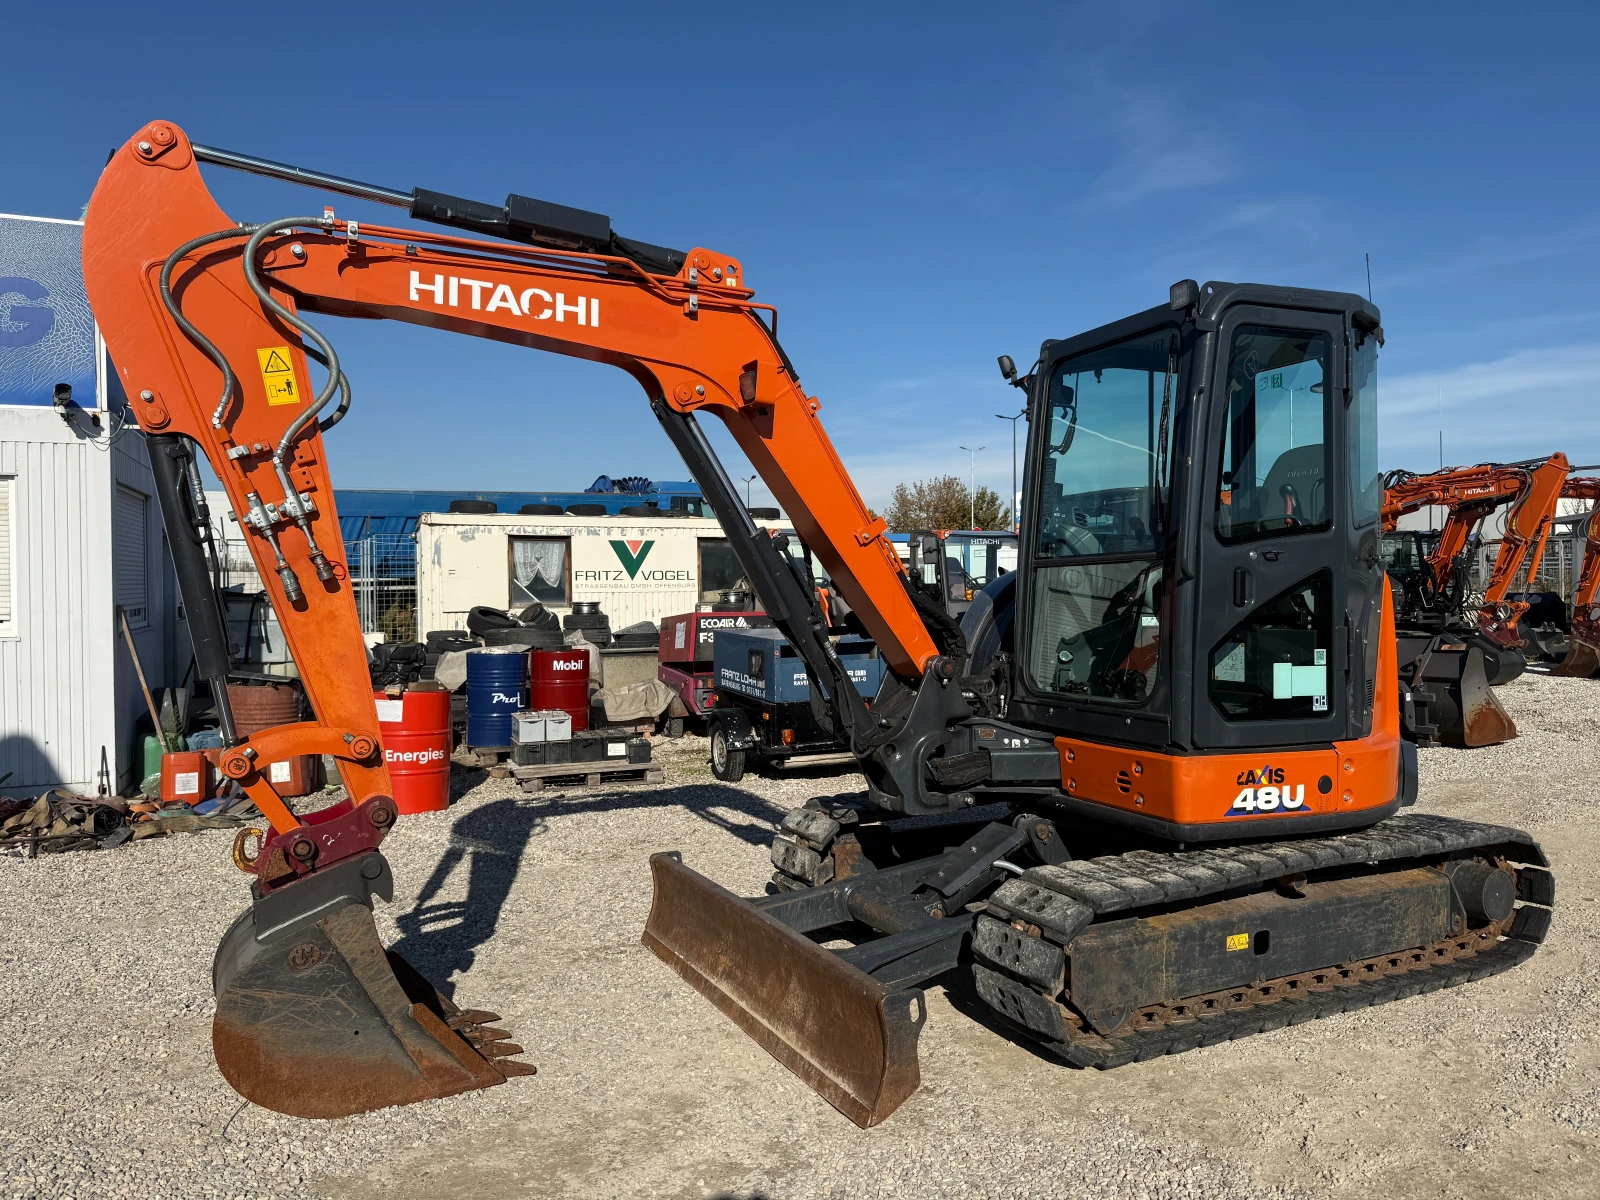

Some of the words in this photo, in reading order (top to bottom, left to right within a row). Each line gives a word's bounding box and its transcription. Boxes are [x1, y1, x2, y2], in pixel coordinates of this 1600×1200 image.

[409, 270, 600, 328] HITACHI
[575, 570, 624, 581] FRITZ
[641, 570, 696, 581] VOGEL
[700, 618, 735, 629] ECOAIR
[553, 660, 583, 671] Mobil
[385, 748, 444, 764] Energies
[1232, 784, 1305, 814] 48U
